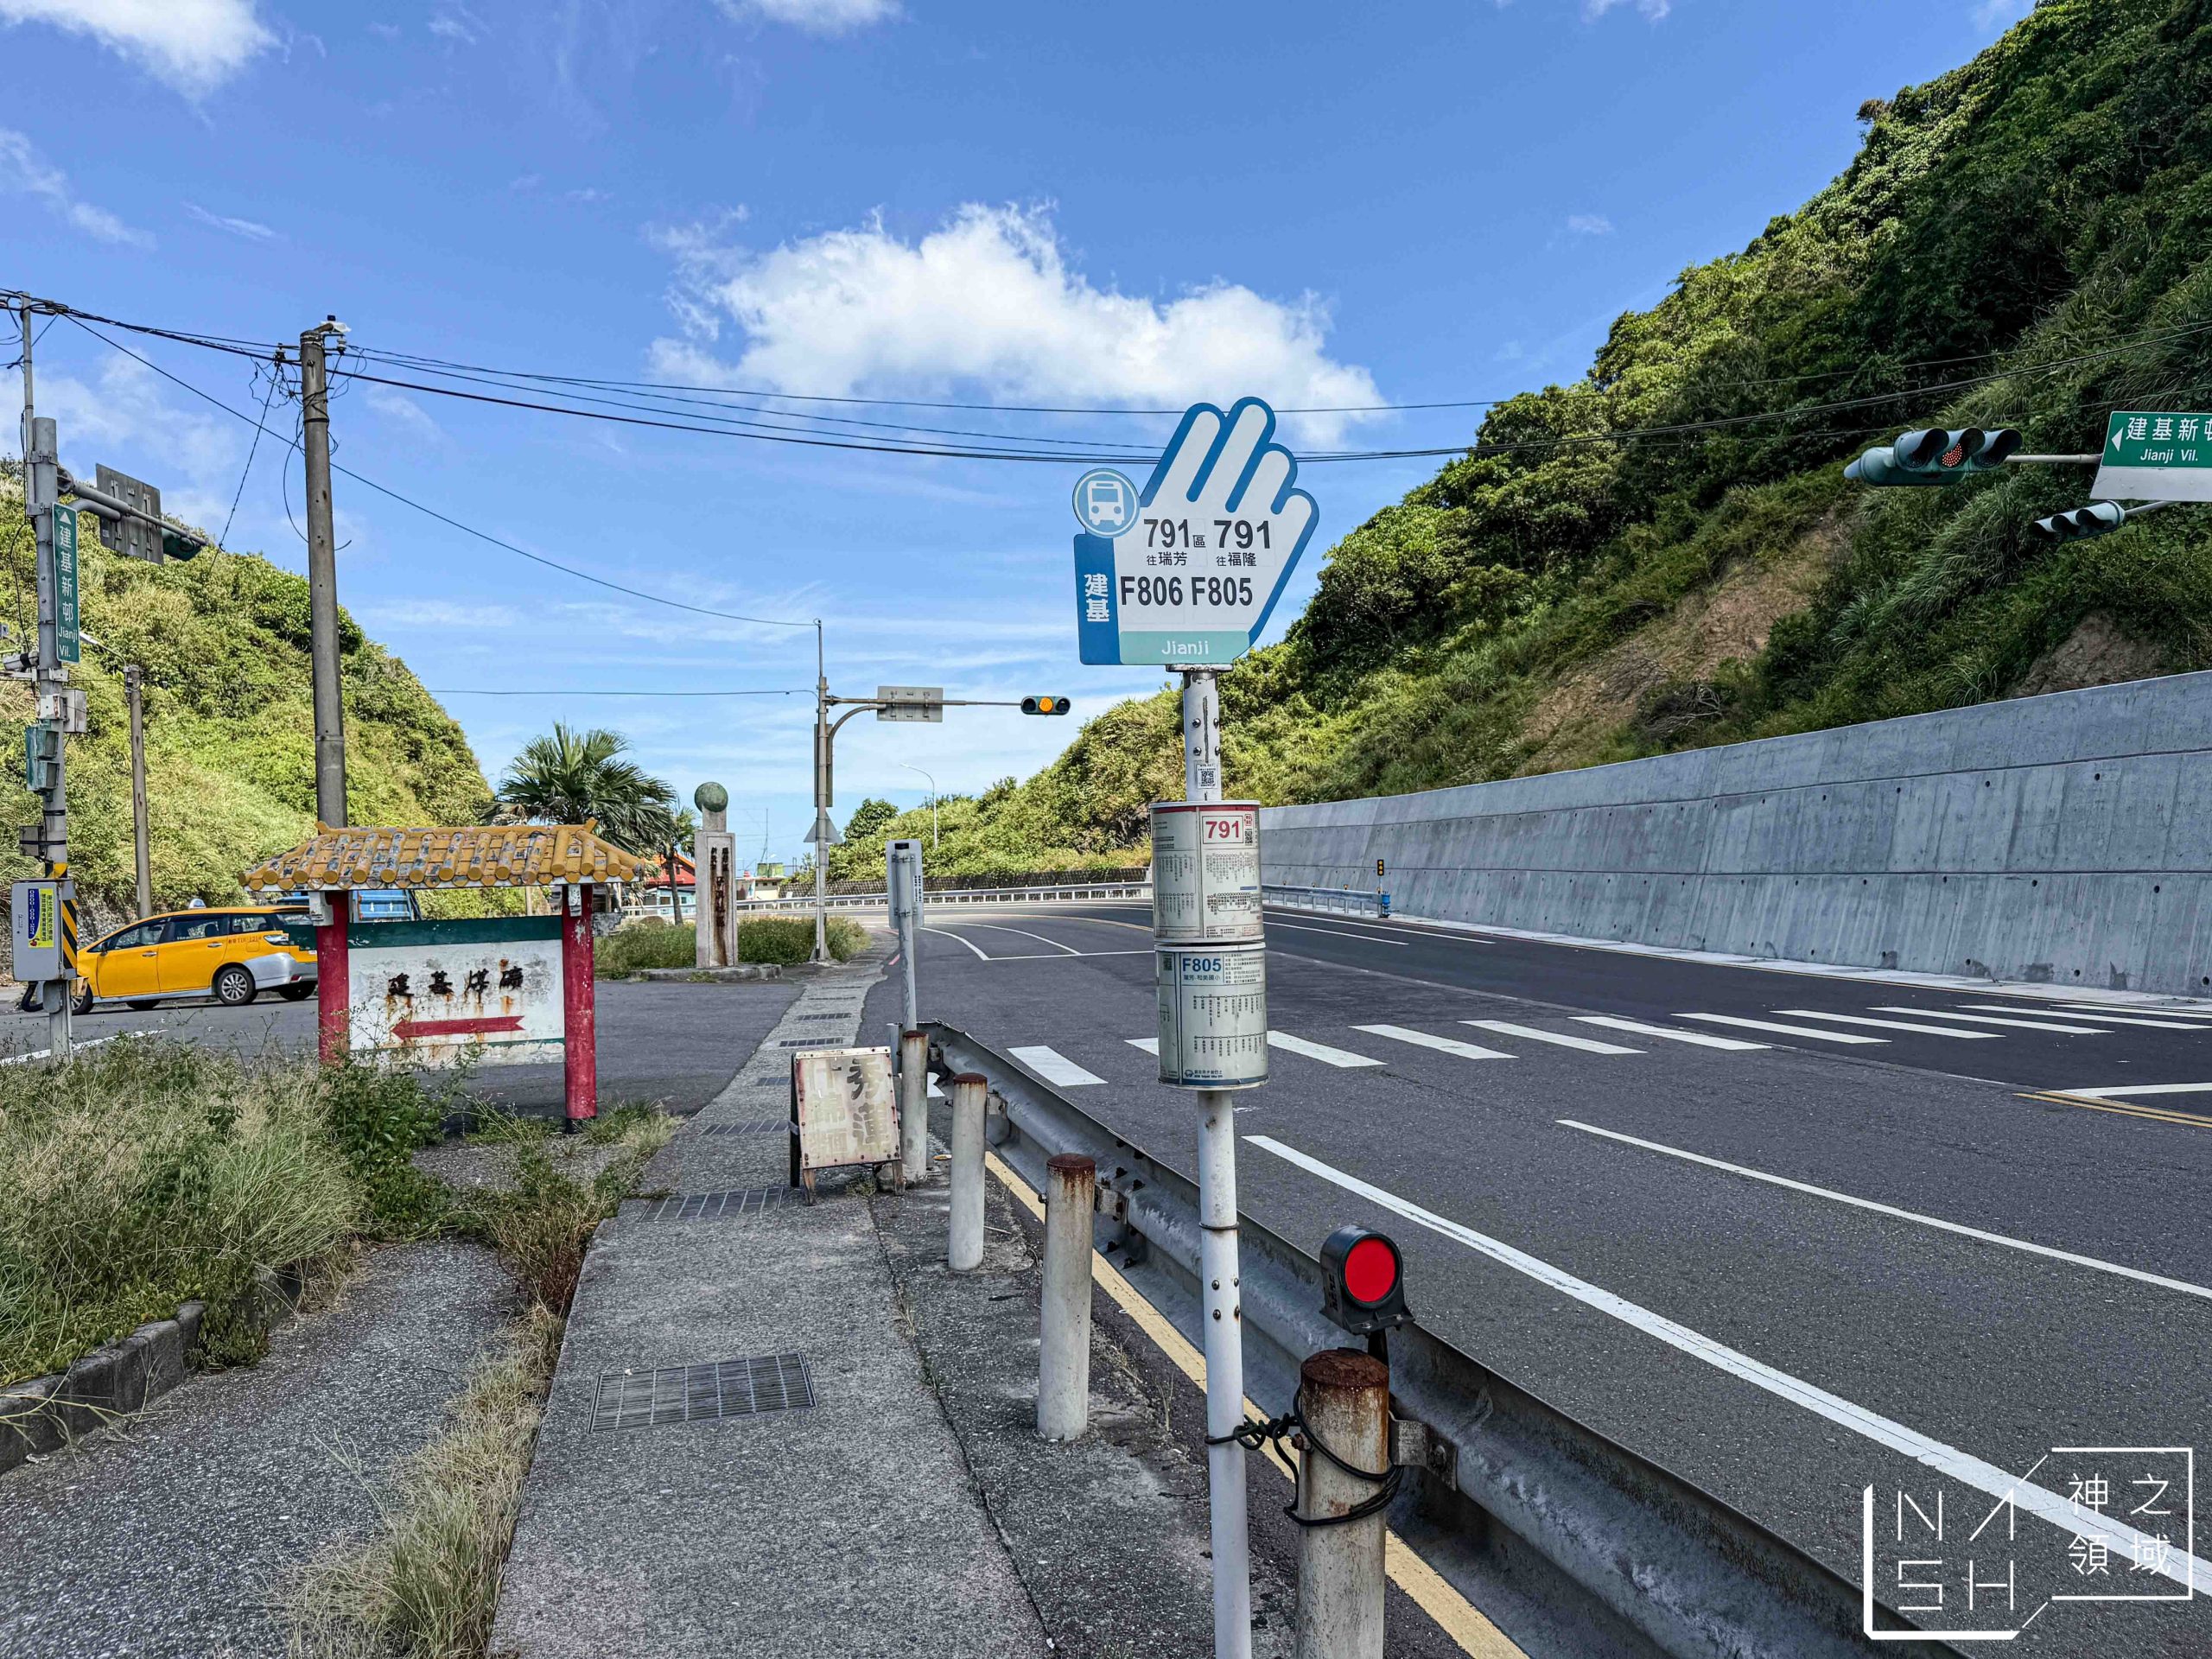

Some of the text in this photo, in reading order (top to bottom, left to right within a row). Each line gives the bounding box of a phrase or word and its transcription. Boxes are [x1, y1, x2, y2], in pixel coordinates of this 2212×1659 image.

[2140, 448, 2198, 464] Jianji Vil.
[1214, 520, 1270, 549] 791
[1147, 551, 1257, 567] 往瑞芳 往福隆
[60, 525, 74, 622] 建基新邨
[1084, 573, 1109, 622] 建基
[1120, 575, 1253, 607] F806 F805
[58, 626, 78, 643] Jianji
[59, 645, 71, 658] Vil.
[1161, 640, 1210, 657] Jianji
[1205, 820, 1240, 839] 791
[1182, 957, 1222, 972] F805
